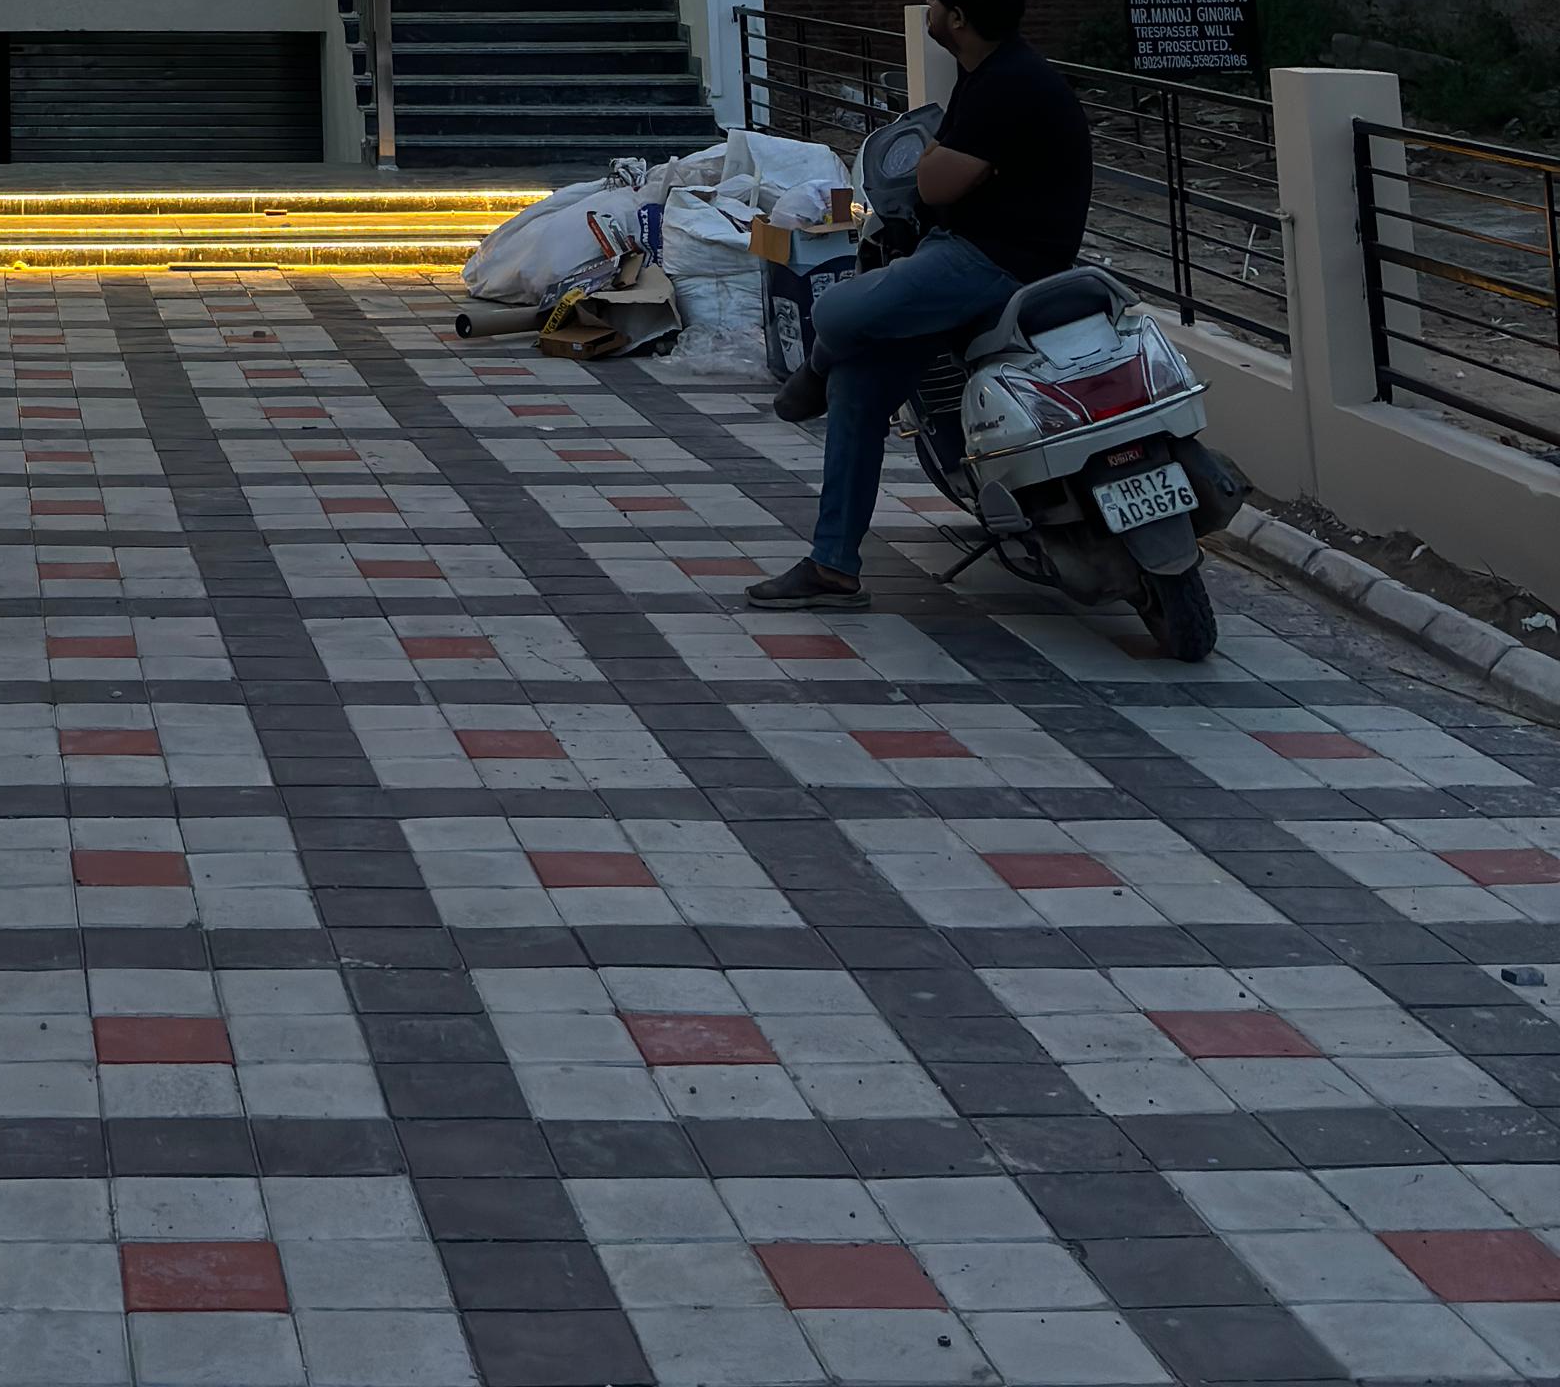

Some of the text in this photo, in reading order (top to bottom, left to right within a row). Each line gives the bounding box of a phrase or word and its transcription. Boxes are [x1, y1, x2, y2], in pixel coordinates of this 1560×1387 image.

[1196, 6, 1245, 22] GINORIA
[1134, 24, 1235, 38] TRESPASSER WILL
[1137, 39, 1233, 54] BE PROSECUTED.
[1118, 487, 1193, 528] AD3676
